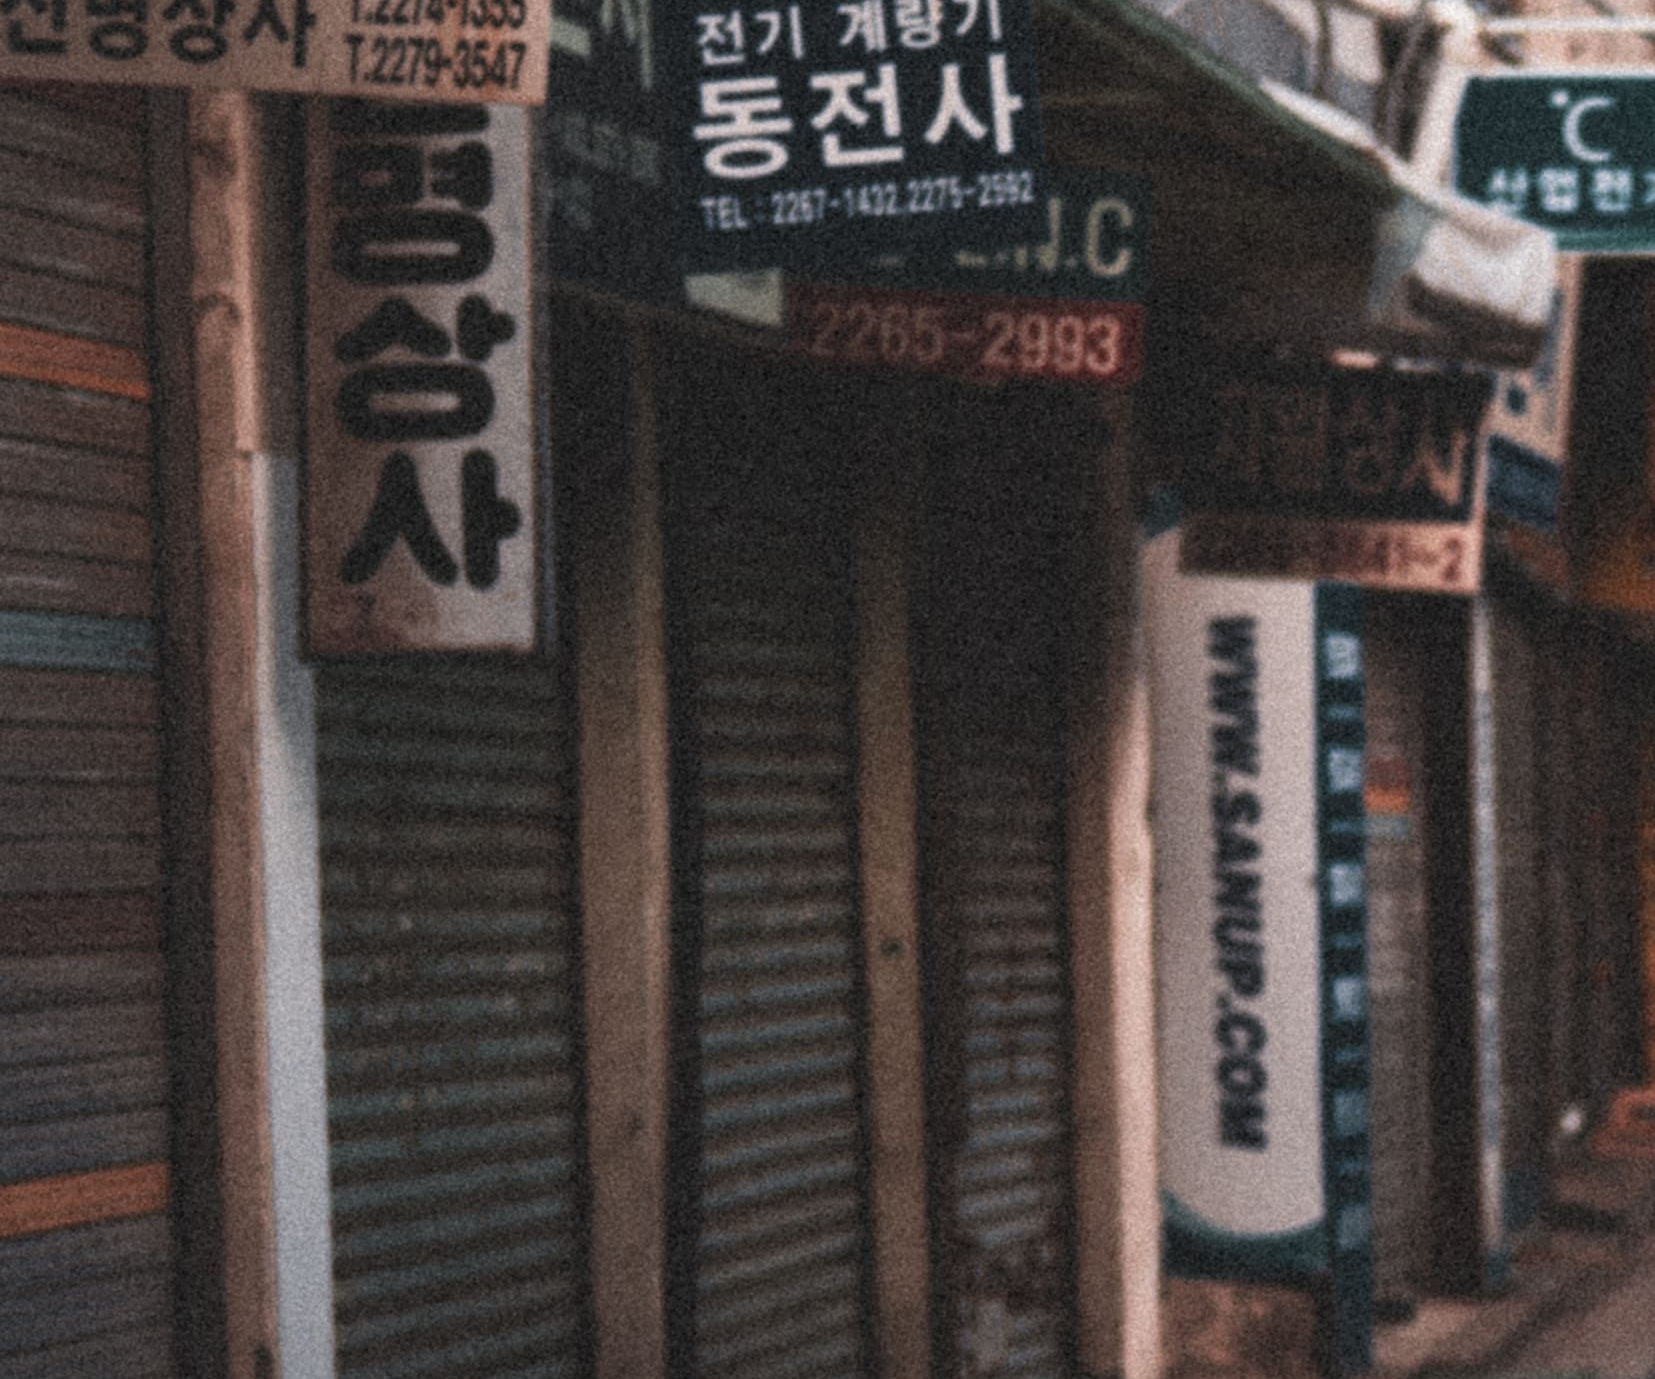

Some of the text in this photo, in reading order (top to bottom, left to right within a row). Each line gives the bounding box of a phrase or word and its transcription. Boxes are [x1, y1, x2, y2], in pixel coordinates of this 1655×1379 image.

[344, 35, 528, 90] T.2279-3547
[697, 5, 803, 66] 전기
[692, 52, 1024, 179] 동전사
[330, 106, 524, 589] 명상사
[1209, 611, 1268, 1153] WWW.SANUP.COM
